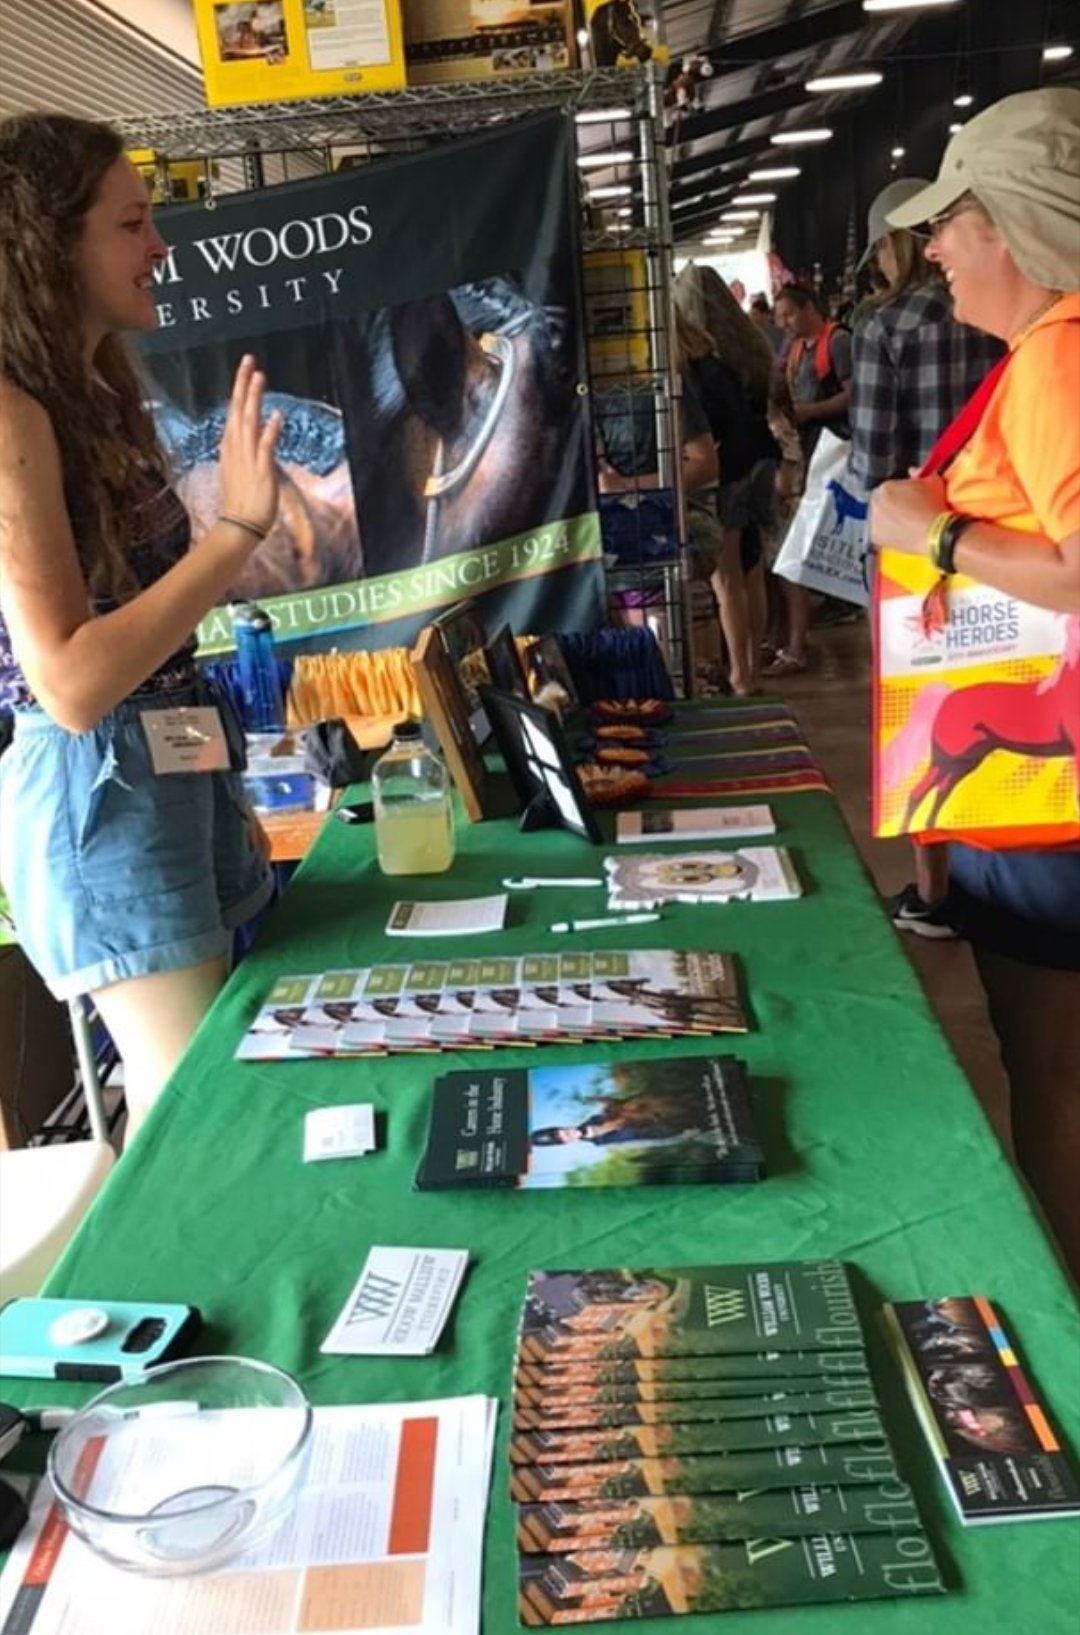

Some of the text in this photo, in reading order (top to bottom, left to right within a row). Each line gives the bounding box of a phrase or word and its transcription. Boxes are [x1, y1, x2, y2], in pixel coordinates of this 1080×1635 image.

[192, 205, 373, 275] WOODS
[269, 582, 401, 629] STUDIES
[410, 550, 499, 598] SINCE
[511, 534, 569, 567] 1924
[945, 622, 1019, 648] HEROES
[951, 600, 1019, 627] HORSE
